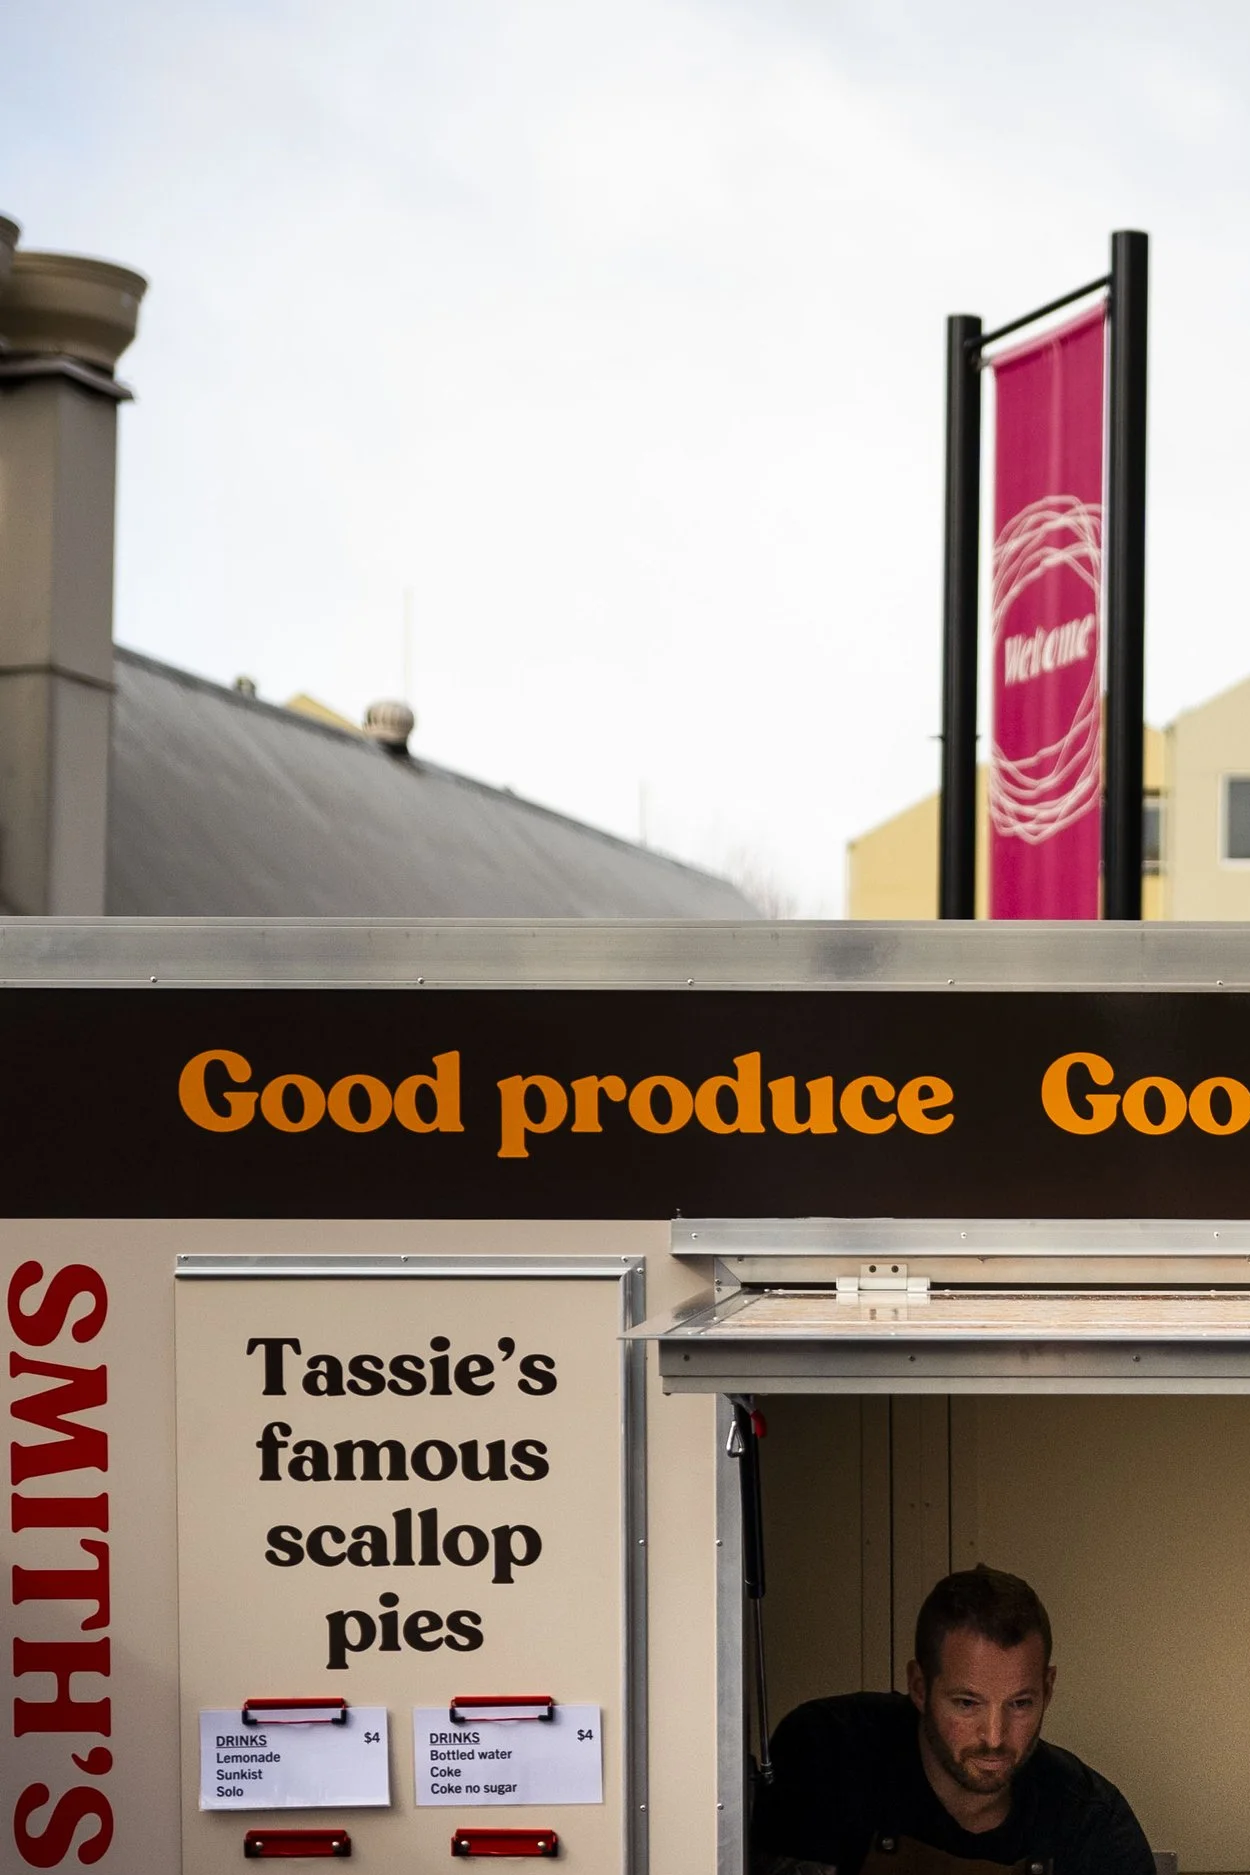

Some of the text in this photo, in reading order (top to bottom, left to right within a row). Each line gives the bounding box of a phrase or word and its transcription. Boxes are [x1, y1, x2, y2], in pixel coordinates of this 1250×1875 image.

[1005, 612, 1095, 687] Welcome
[179, 1050, 954, 1157] Good produce
[246, 1336, 557, 1396] Tassie's
[256, 1422, 549, 1481] famous
[265, 1508, 542, 1584] scallop
[6, 1261, 114, 1868] SMITH'S
[326, 1592, 483, 1669] pies
[216, 1735, 267, 1747] DRINKS
[364, 1732, 380, 1744] $4
[430, 1732, 480, 1743] DRINKS
[578, 1729, 593, 1741] $4
[217, 1752, 280, 1763] Lemonade
[431, 1749, 512, 1761] Bottled water
[217, 1769, 262, 1780] Sunkist
[431, 1767, 461, 1777] Coke
[217, 1786, 243, 1797] Solo
[431, 1783, 517, 1795] Coke no sugar
